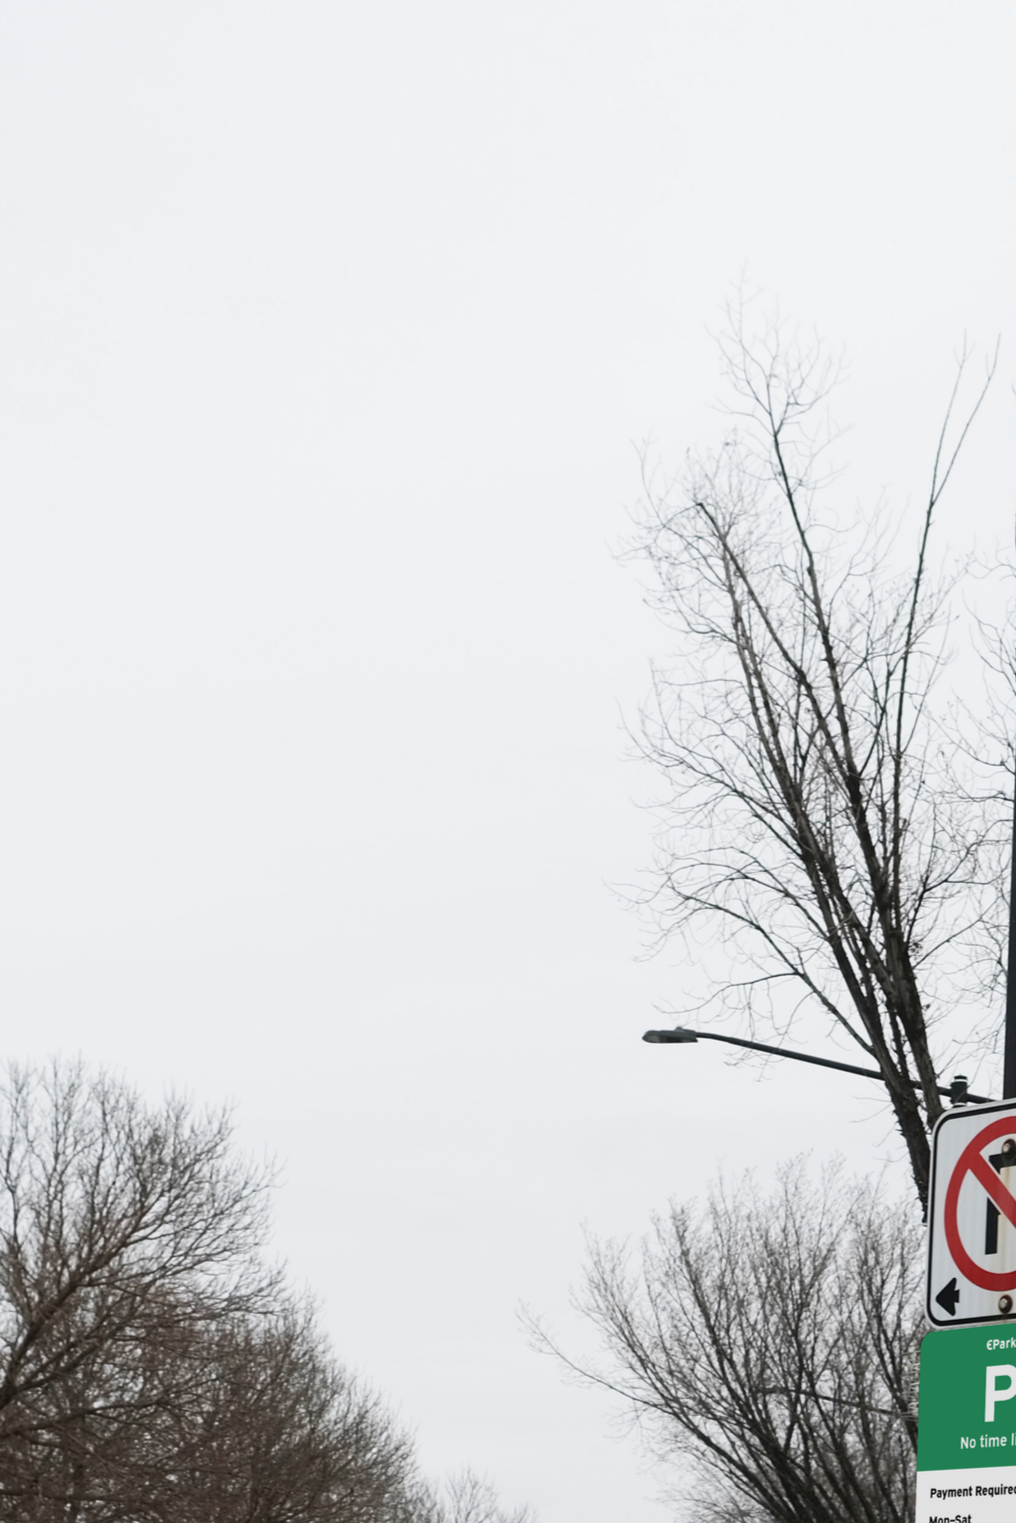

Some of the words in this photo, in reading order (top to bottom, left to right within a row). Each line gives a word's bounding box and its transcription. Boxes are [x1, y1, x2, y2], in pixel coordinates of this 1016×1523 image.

[960, 1436, 976, 1450] No
[979, 1434, 1008, 1448] time
[930, 1486, 973, 1501] Payment
